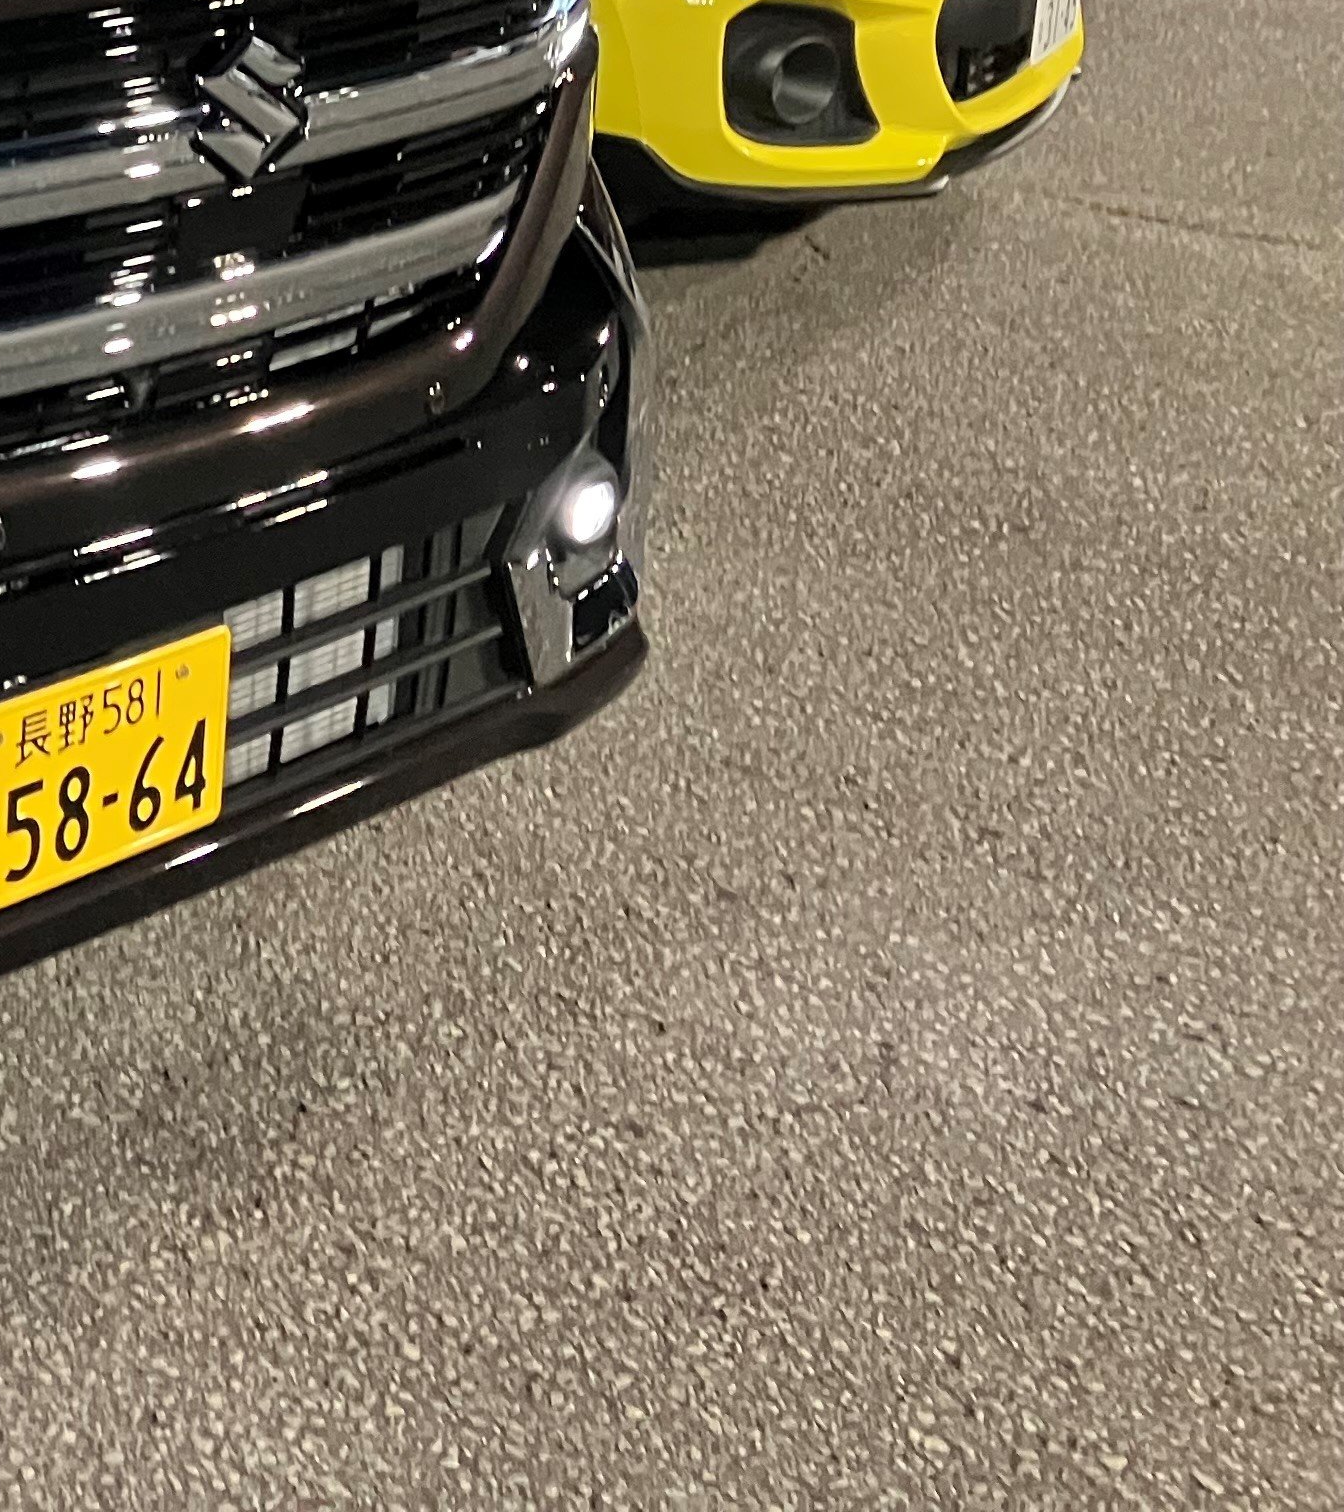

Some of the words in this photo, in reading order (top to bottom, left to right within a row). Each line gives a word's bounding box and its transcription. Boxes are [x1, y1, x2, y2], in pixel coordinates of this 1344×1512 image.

[14, 695, 94, 768] 長野
[103, 669, 162, 737] 581
[4, 718, 207, 883] 58-64
